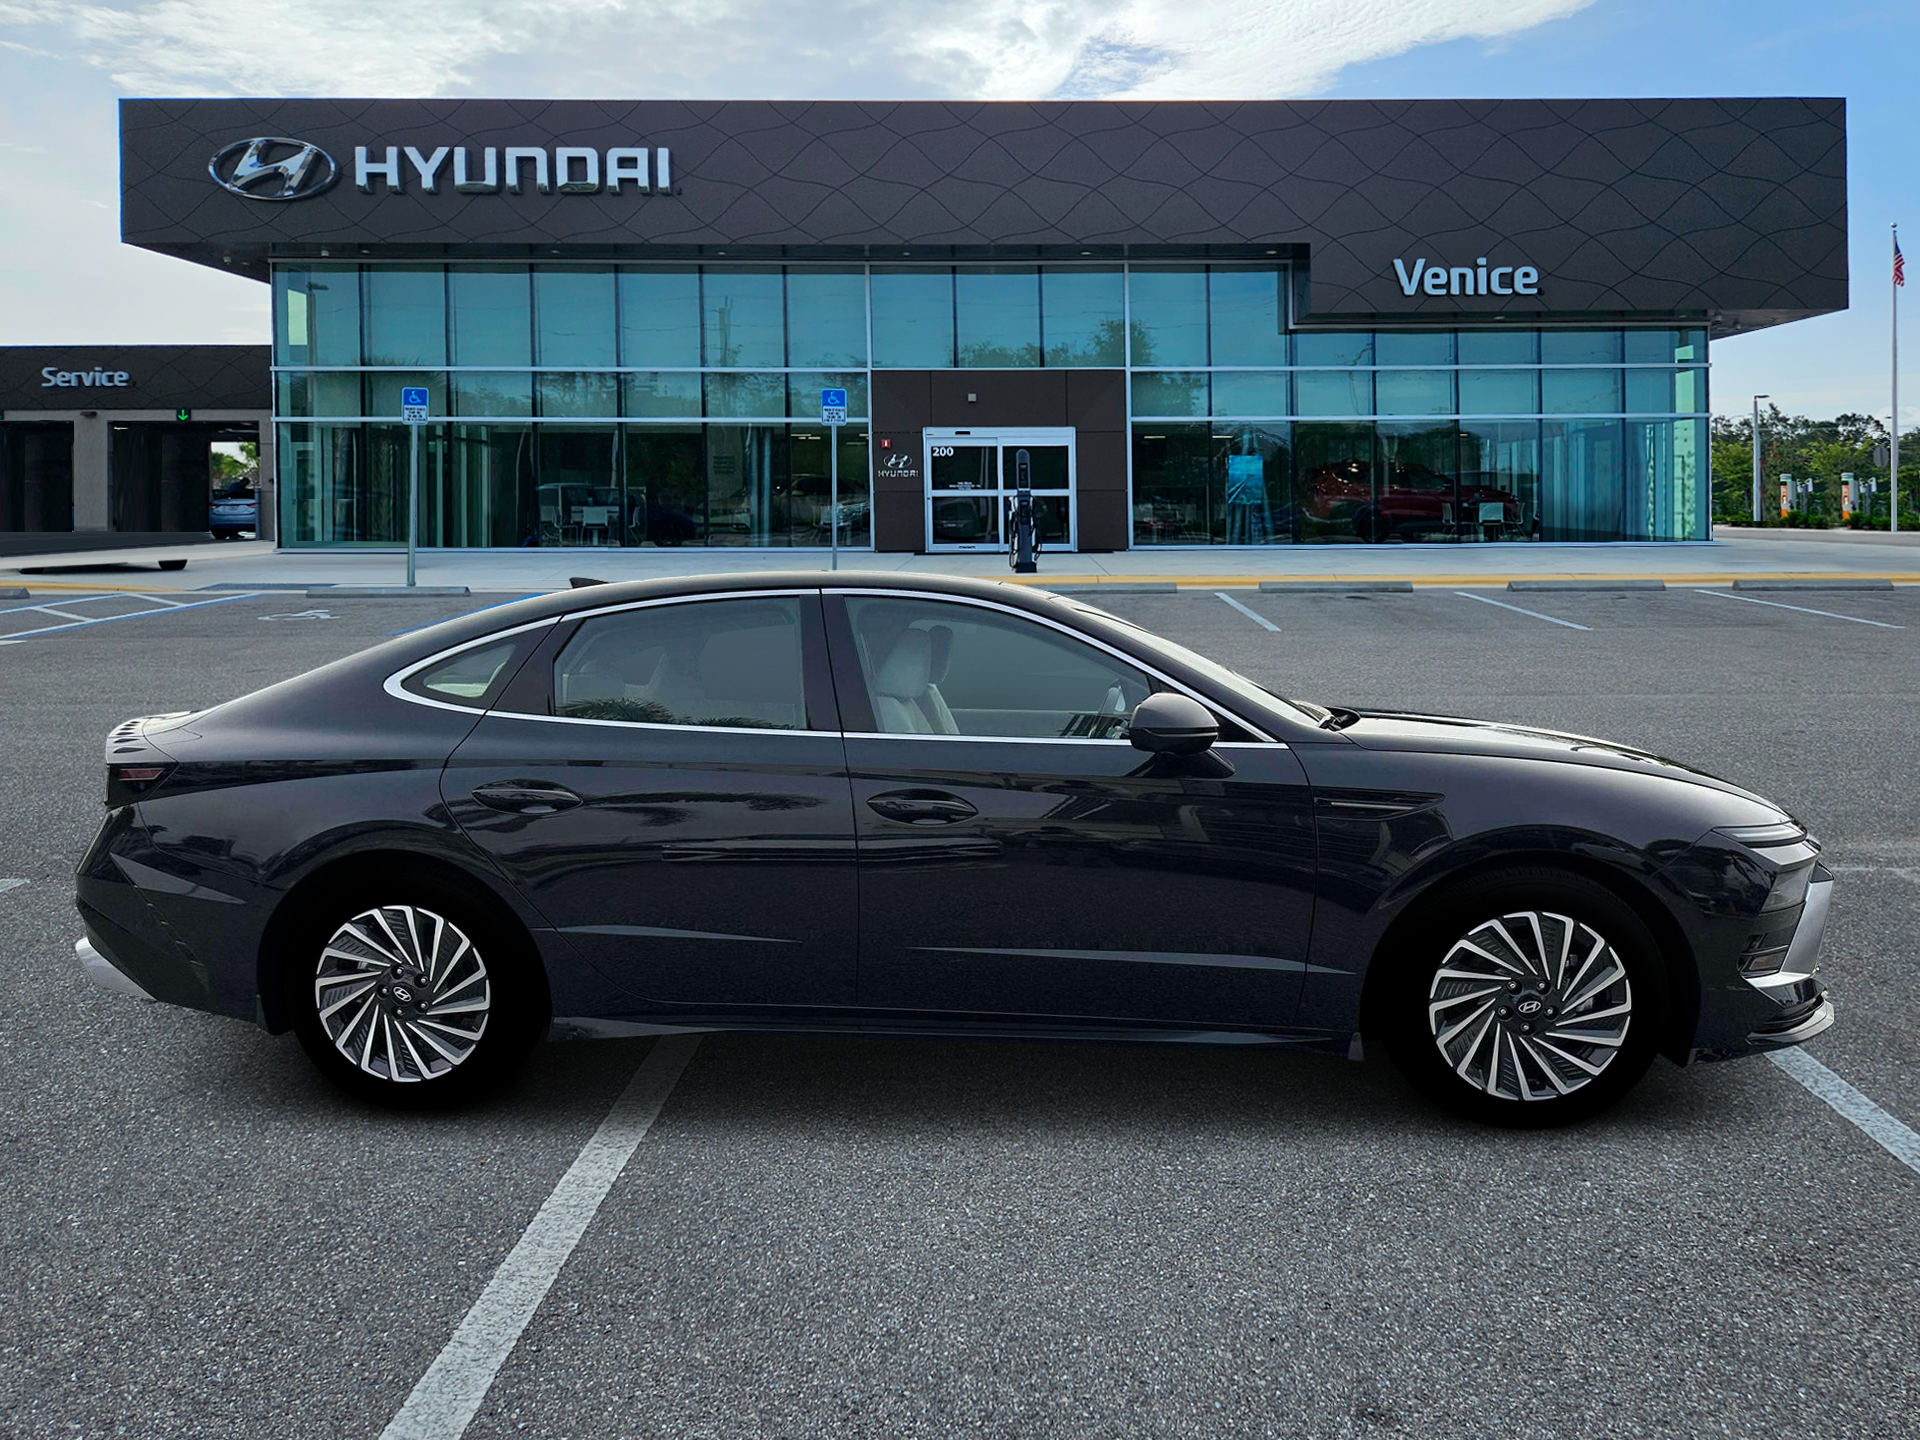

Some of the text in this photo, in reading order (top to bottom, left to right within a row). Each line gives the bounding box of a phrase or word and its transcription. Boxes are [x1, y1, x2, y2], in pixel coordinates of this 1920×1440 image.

[354, 145, 672, 194] HYUNDAI
[1392, 256, 1539, 296] Venice
[41, 366, 130, 387] Service
[932, 446, 954, 457] 200
[878, 469, 919, 478] HYUNDAI
